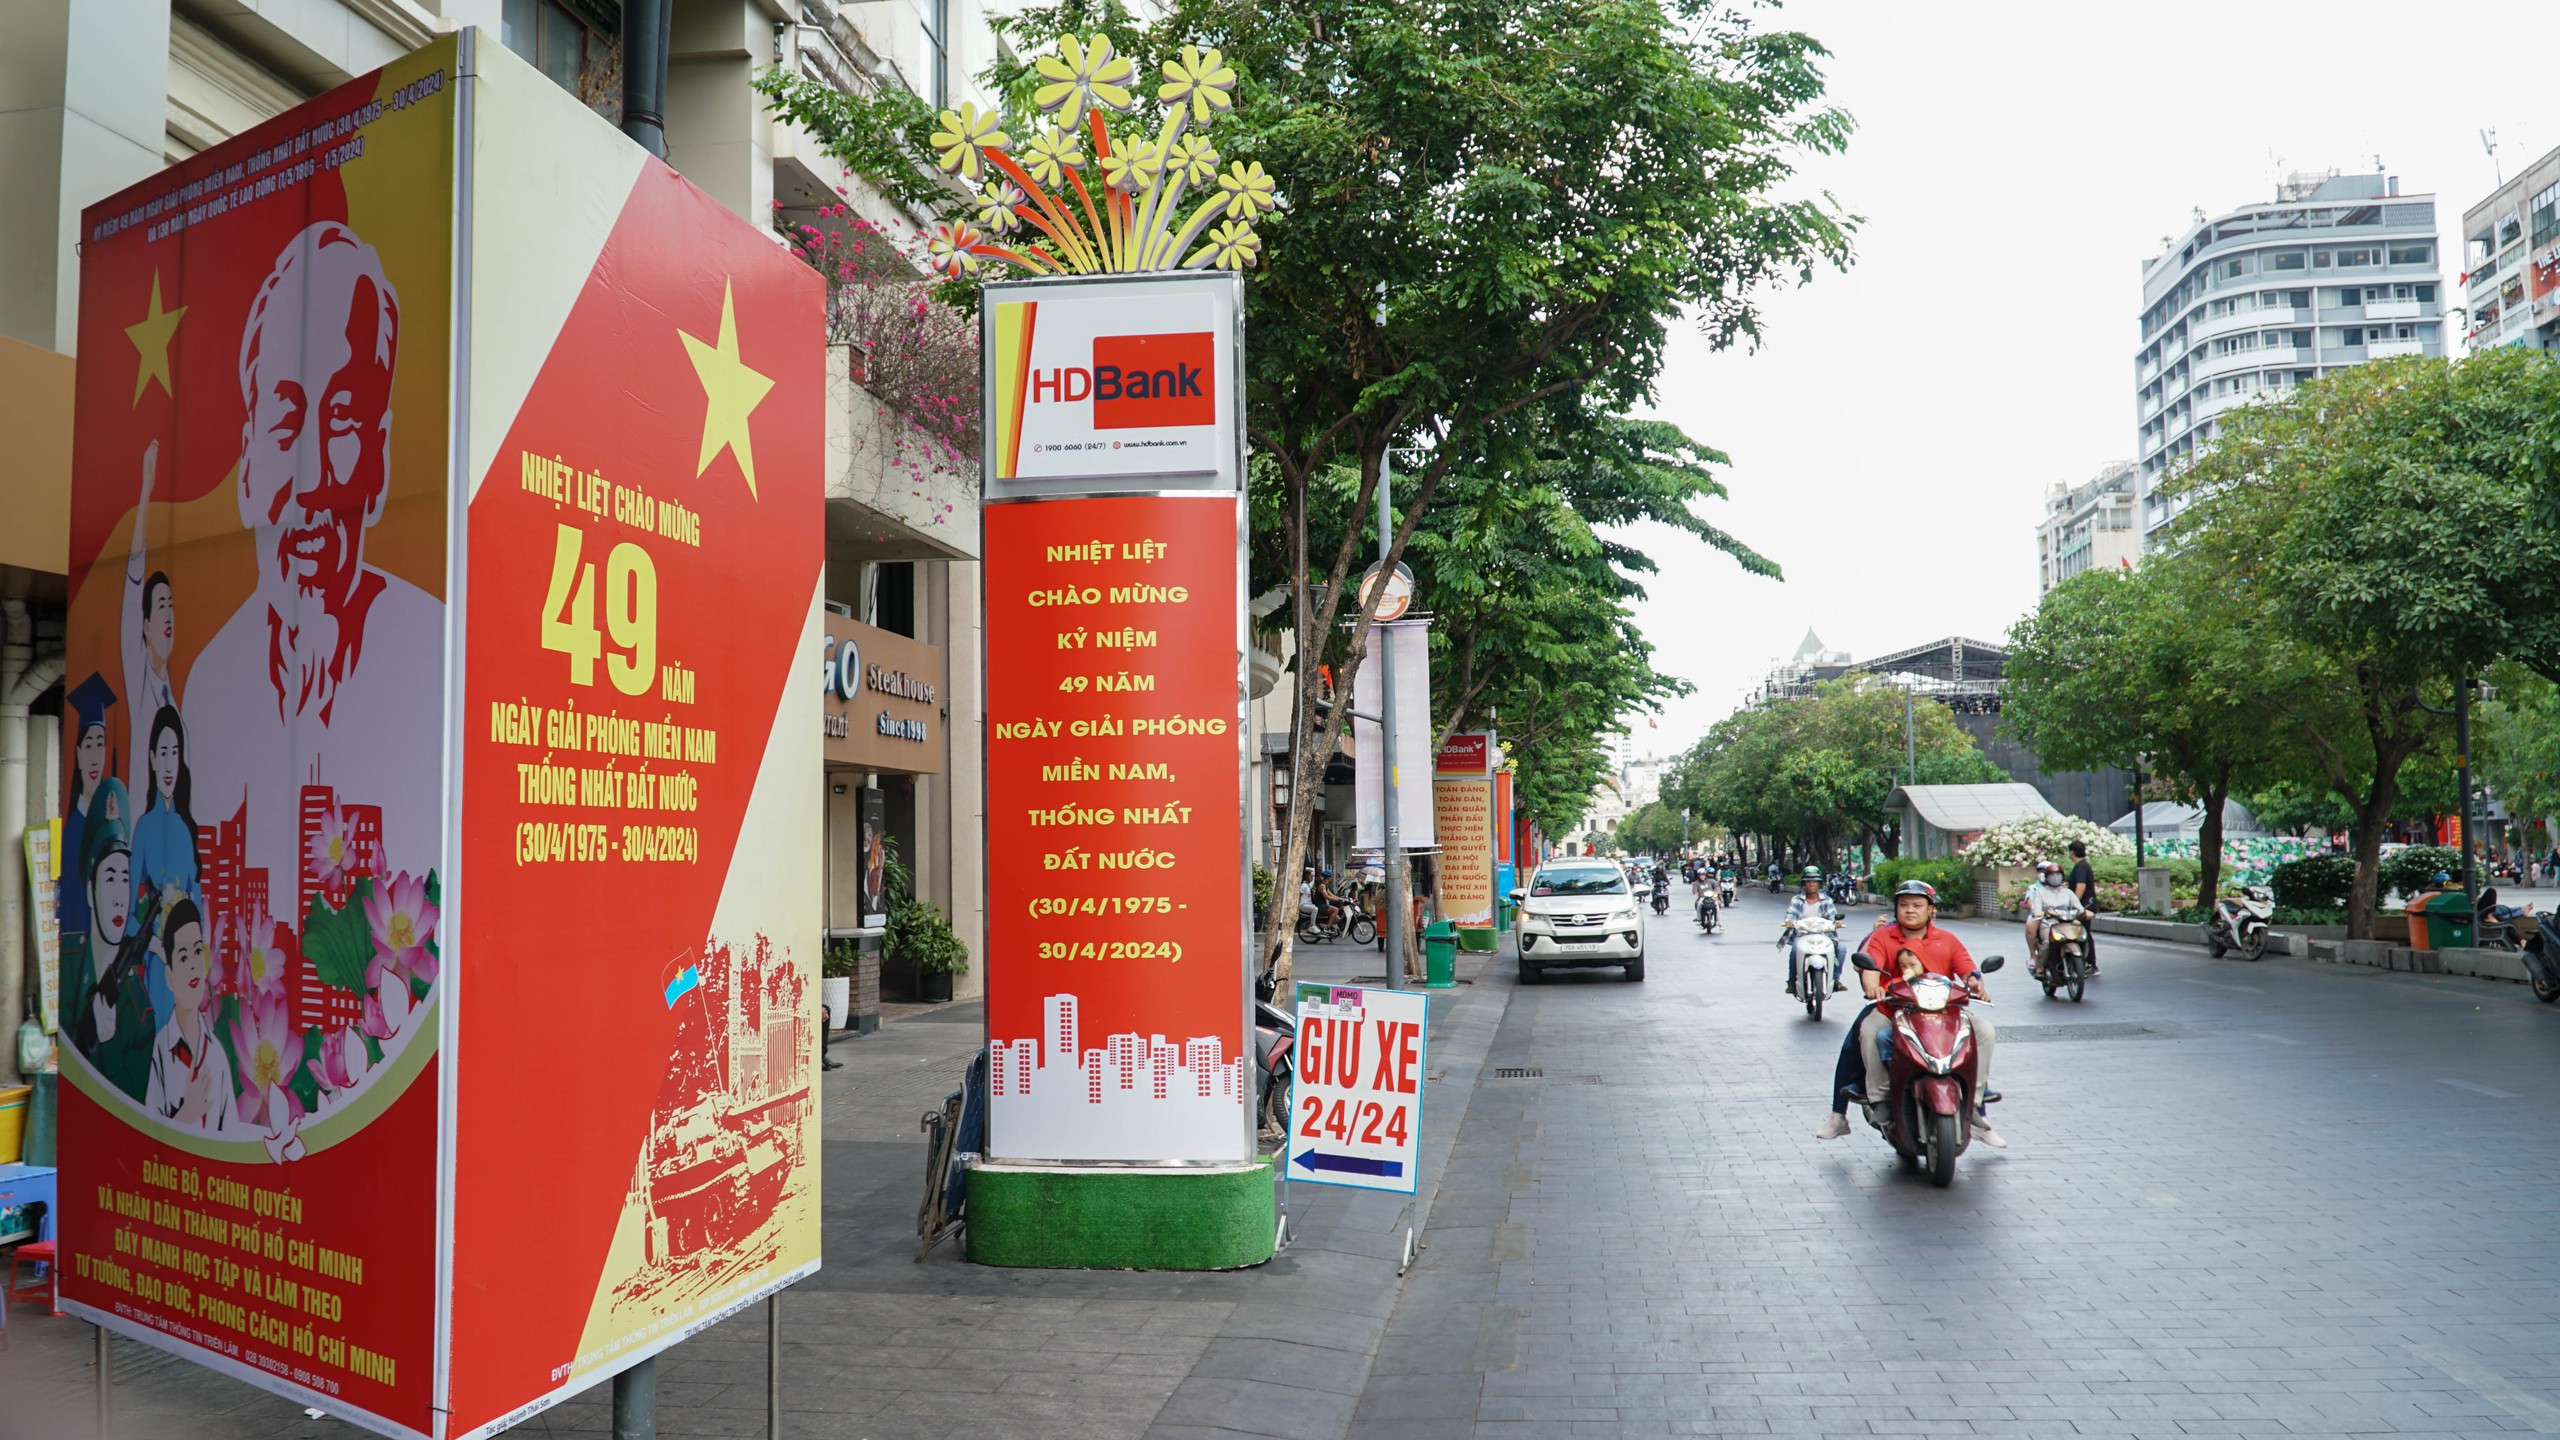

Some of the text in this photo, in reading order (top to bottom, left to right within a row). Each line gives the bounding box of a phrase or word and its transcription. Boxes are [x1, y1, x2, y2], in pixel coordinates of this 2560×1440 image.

[103, 69, 444, 238] NIỆM 49 NĂM NGÀY GIẢI MIỀN NAM, THỐNG NHẤT ĐẤT NƯỚC (30/4/1975 30/4/2024)
[170, 212, 186, 234] NĂM
[188, 202, 207, 227] NGÀY
[208, 192, 228, 218] QUỐC
[229, 185, 238, 209] TẾ
[240, 184, 254, 206] LAO
[255, 175, 276, 200] ĐỘNG
[278, 158, 315, 190] (1/5/1886
[324, 135, 365, 171] 1/5/2024)
[1033, 362, 1202, 403] HDBank
[1084, 442, 1106, 450] (24/7)
[1124, 440, 1187, 448] www.hdbank.com.vn
[521, 450, 700, 548] NHIỆT LIỆT CHÀO MỪNG
[1047, 538, 1167, 565] NHIỆT LIỆT
[541, 523, 695, 705] 49 NĂM
[1028, 582, 1188, 607] CHÀO MỪNG
[1057, 627, 1157, 652] KỶ NIỆM
[868, 663, 935, 703] Steakhouse
[1059, 672, 1154, 693] 49 NĂM
[491, 696, 716, 764] NGÀY GIẢI PHÓNG MIỀN NAM
[879, 710, 926, 740] Since 1998
[996, 714, 1227, 739] NGÀY GIẢI PHÓNG
[517, 752, 697, 812] THỐNG NHẤT ĐẤT NƯỚC
[1042, 756, 1175, 783] MIỀN NAM,
[1028, 800, 1192, 826] THỐNG NHẤT
[516, 822, 698, 867] (30/4/1975 30/4/2024)
[1440, 833, 1468, 841] THẮNG
[1044, 846, 1176, 870] ĐẤT NƯỚC
[1462, 861, 1479, 870] BIỂU
[1028, 897, 1171, 919] (30/4/1975
[1038, 941, 1182, 963] 30/4/2024)
[1336, 991, 1358, 1000] MOMO
[1372, 1020, 1419, 1094] XE
[1300, 1096, 1408, 1147] 24/24
[142, 1155, 302, 1225] ĐẢNG BỘ, CHÍNH QUYỀN
[98, 1183, 363, 1286] VÀ NHÂN DÂN THÀNH PHỐ HỒ CHÍ MINH
[115, 1221, 342, 1323] ĐẨY MẠNH HỌC TẬP VÀ LÀM THEO
[75, 1251, 396, 1387] TƯ TƯỞNG, ĐẠO ĐỨC, PHONG CÁCH HỒ CHÍ MINH
[115, 1302, 132, 1317] ĐVTH:
[134, 1308, 154, 1325] TRUNG
[155, 1315, 168, 1330] TÂM
[169, 1321, 191, 1339] THÔNG
[192, 1330, 203, 1343] TIN
[204, 1333, 222, 1351] TRIỂN
[245, 1349, 257, 1368] 028
[258, 1355, 289, 1376] 39302158
[294, 1367, 311, 1384] 0908
[312, 1374, 325, 1389] 508
[326, 1379, 339, 1394] 700
